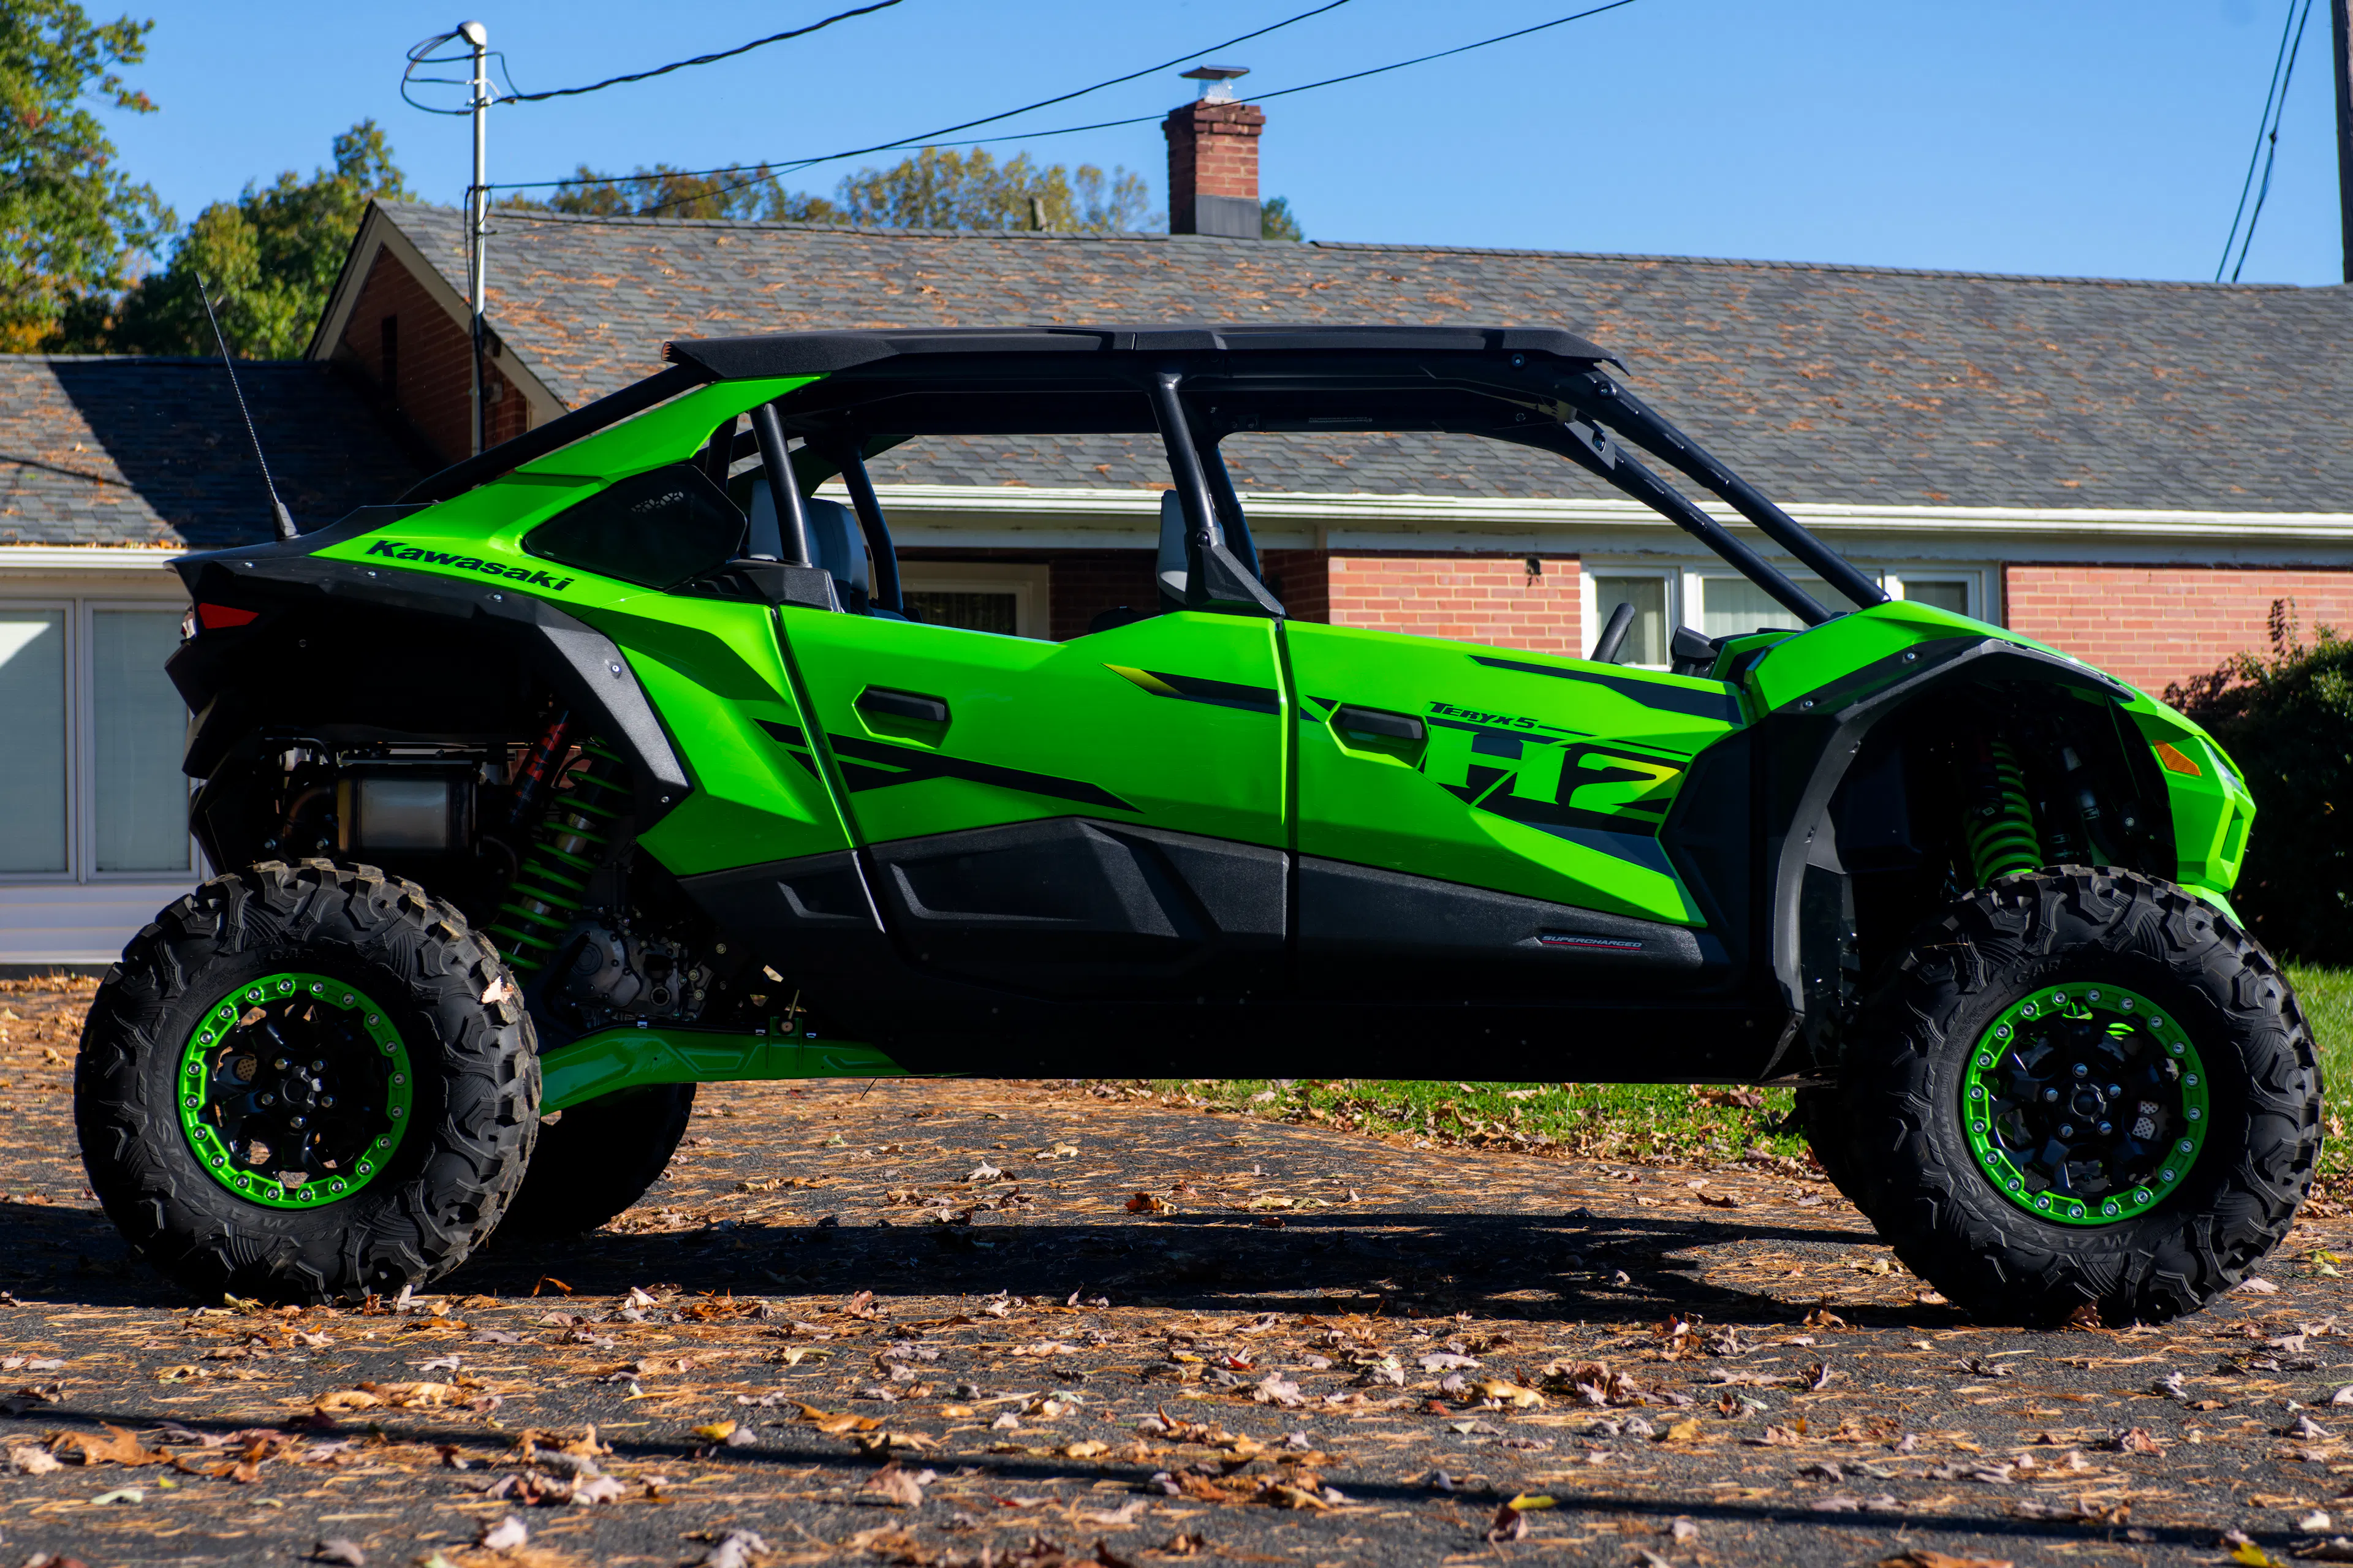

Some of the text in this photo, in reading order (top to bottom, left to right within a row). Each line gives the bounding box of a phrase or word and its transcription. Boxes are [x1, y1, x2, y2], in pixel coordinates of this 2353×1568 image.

[366, 540, 575, 591] Kawasaki
[1423, 726, 1683, 824] H2
[1542, 935, 1643, 947] SUPERCHARGED
[153, 1114, 298, 1235] MAXXIS
[1955, 1167, 2137, 1252] MAXXIS
